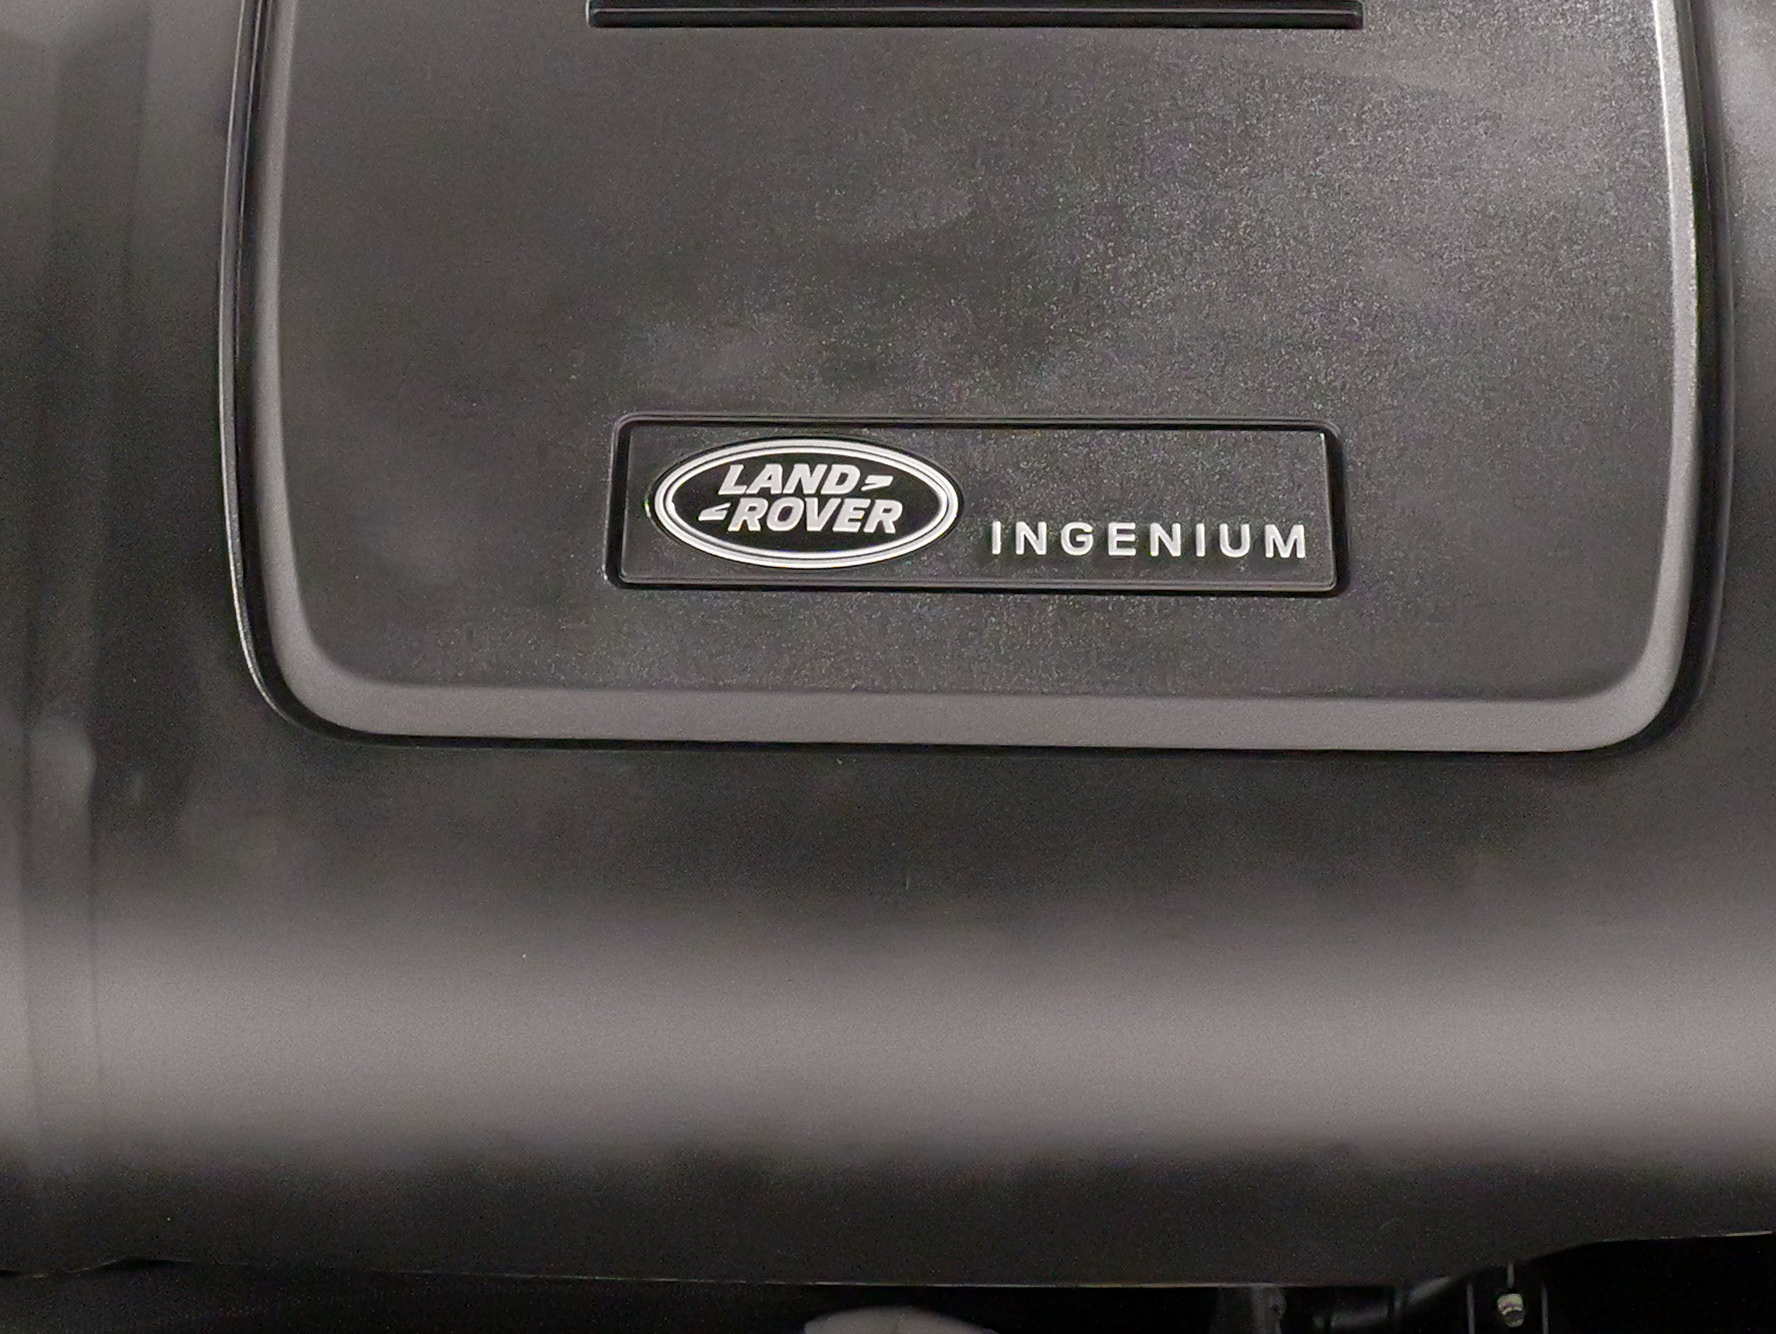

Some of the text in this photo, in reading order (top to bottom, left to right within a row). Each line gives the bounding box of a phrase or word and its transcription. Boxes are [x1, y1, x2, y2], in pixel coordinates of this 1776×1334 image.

[718, 462, 864, 496] LAND
[727, 497, 904, 535] ROVER
[990, 519, 1307, 559] INGENIUM
